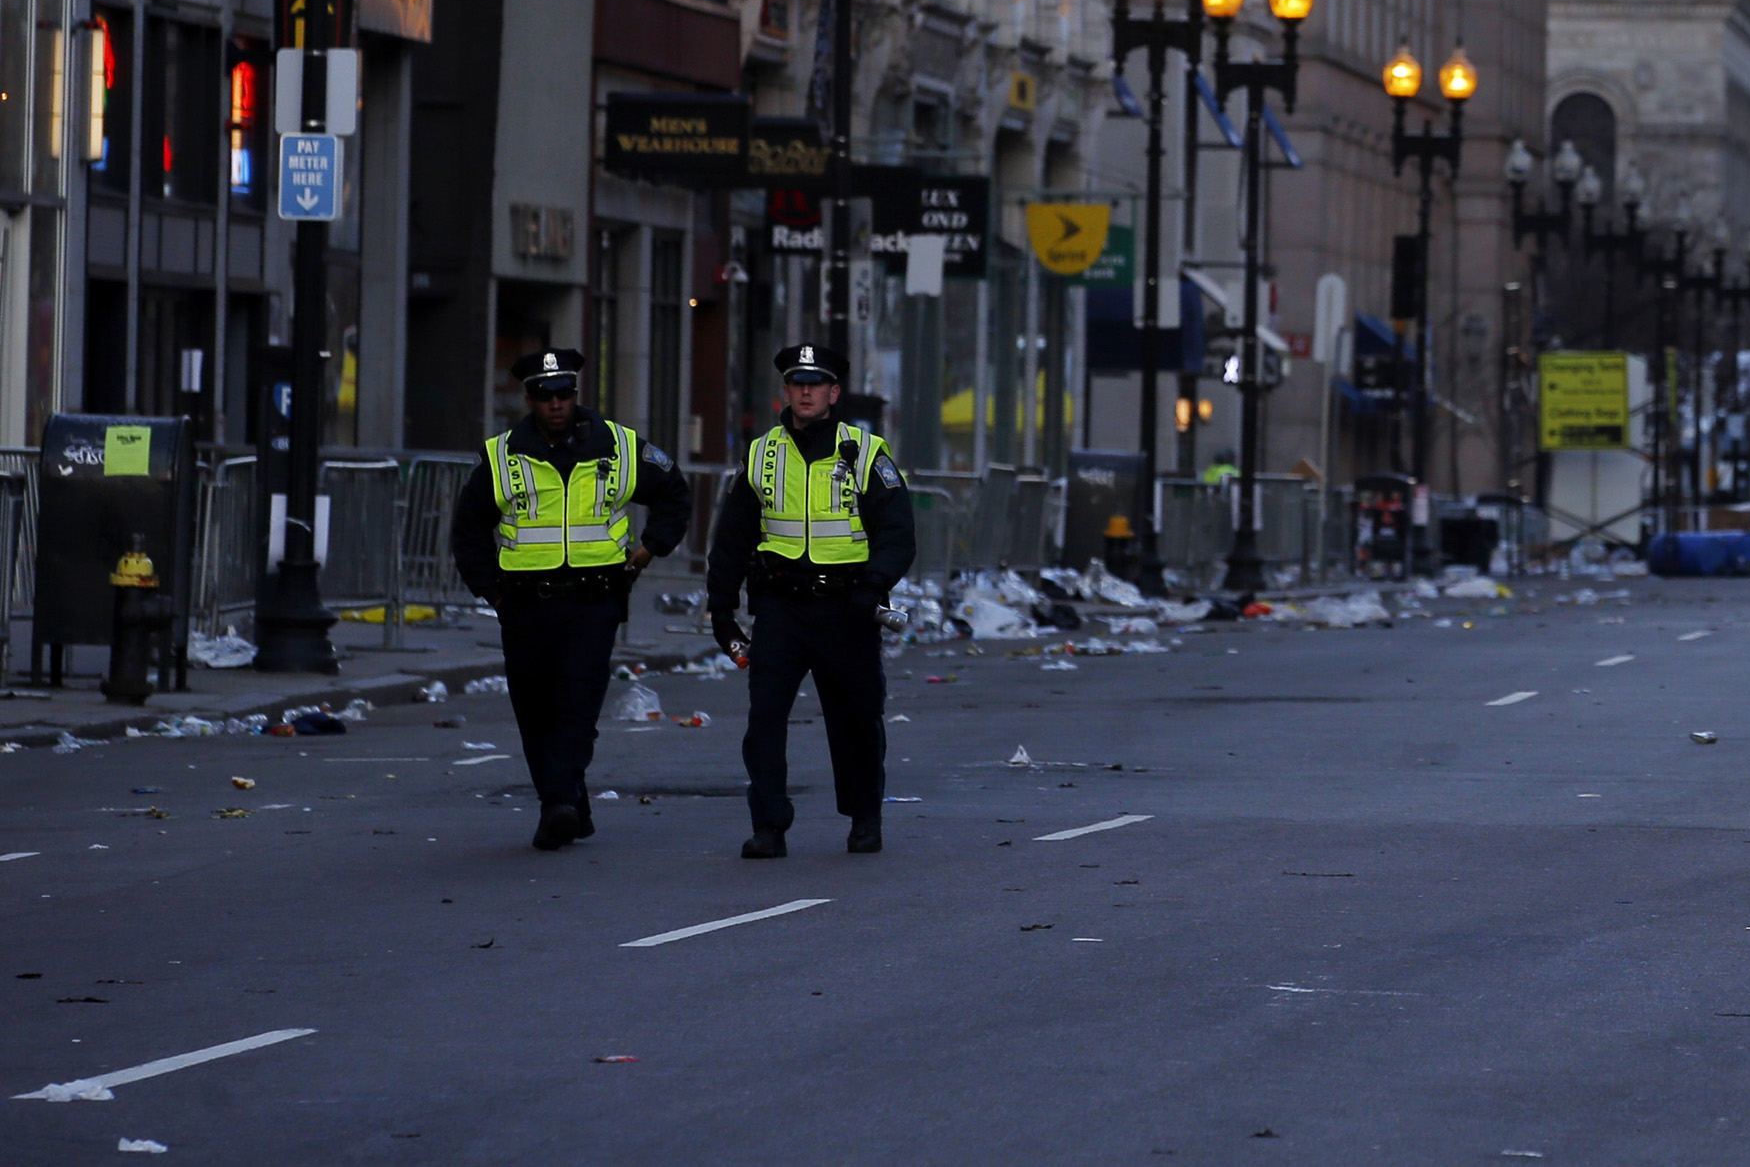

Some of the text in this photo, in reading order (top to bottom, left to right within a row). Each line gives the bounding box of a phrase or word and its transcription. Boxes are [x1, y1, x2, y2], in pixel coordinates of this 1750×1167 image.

[649, 116, 708, 134] MEN'S
[297, 140, 320, 154] PAY
[616, 133, 741, 154] WEARHOUSE
[288, 155, 328, 170] METER
[292, 171, 324, 186] HERE
[921, 211, 969, 229] OND
[508, 454, 527, 511] OSTON
[764, 439, 777, 509] BOSTON
